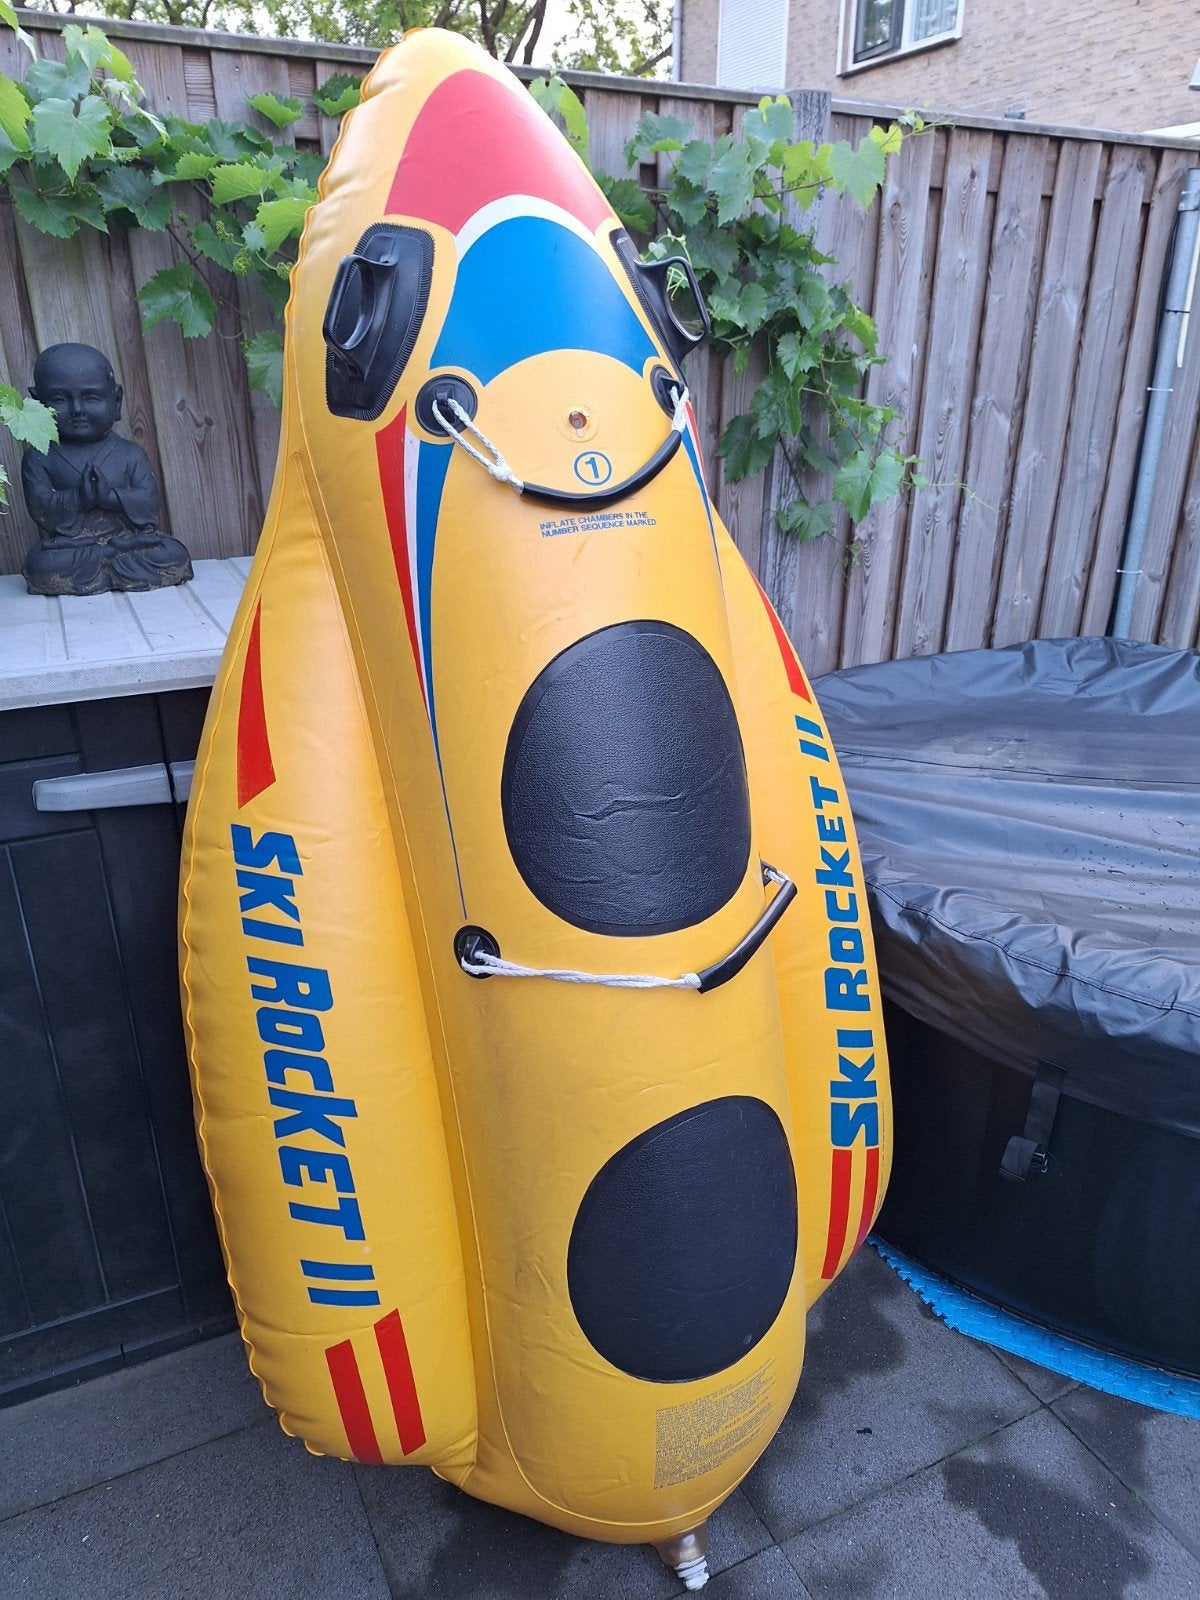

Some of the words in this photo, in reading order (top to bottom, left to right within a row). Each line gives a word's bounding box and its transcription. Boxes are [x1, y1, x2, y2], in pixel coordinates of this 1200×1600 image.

[584, 456, 600, 479] 1
[540, 518, 576, 530] INFLATE
[578, 513, 623, 524] CHAMBERS
[634, 511, 648, 519] THE
[541, 526, 579, 538] NUMBER
[581, 520, 625, 532] SEQUENCE
[626, 518, 657, 527] MARKED
[794, 714, 829, 761] II
[231, 824, 303, 947] SKI
[810, 776, 870, 1012] ROCKET
[247, 957, 366, 1241] ROCKET
[829, 1028, 879, 1148] SKI
[300, 1260, 380, 1307] II
